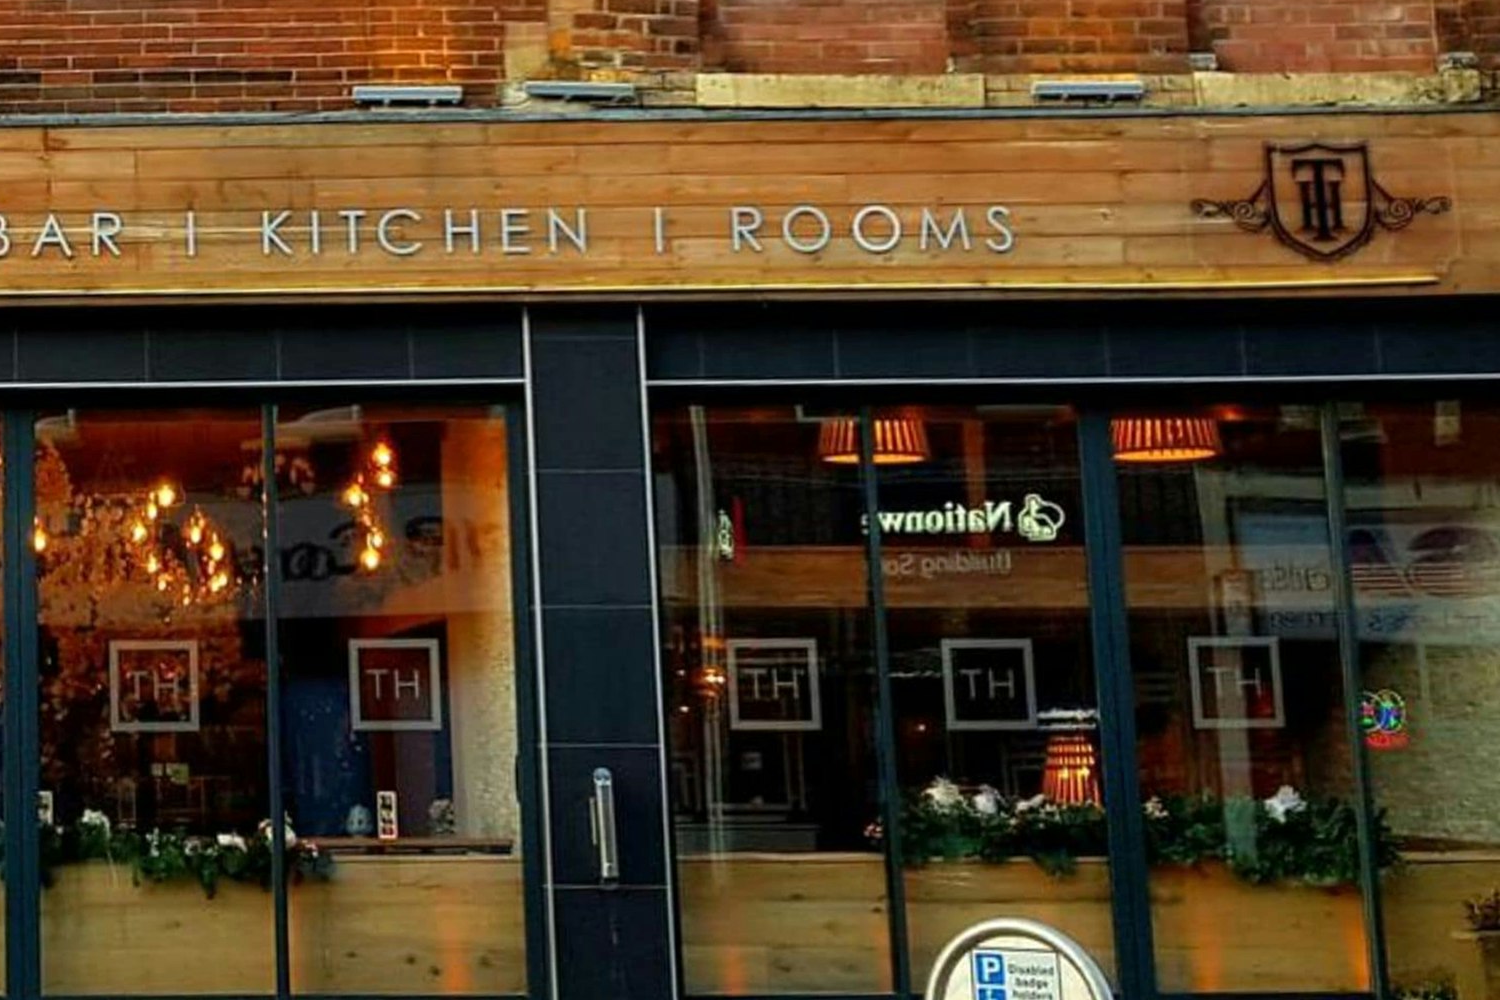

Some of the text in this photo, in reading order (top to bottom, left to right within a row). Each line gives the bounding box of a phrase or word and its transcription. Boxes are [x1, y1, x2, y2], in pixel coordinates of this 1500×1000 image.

[261, 207, 589, 255] KITCHEN
[730, 204, 1015, 254] ROOMS
[981, 956, 1002, 982] P
